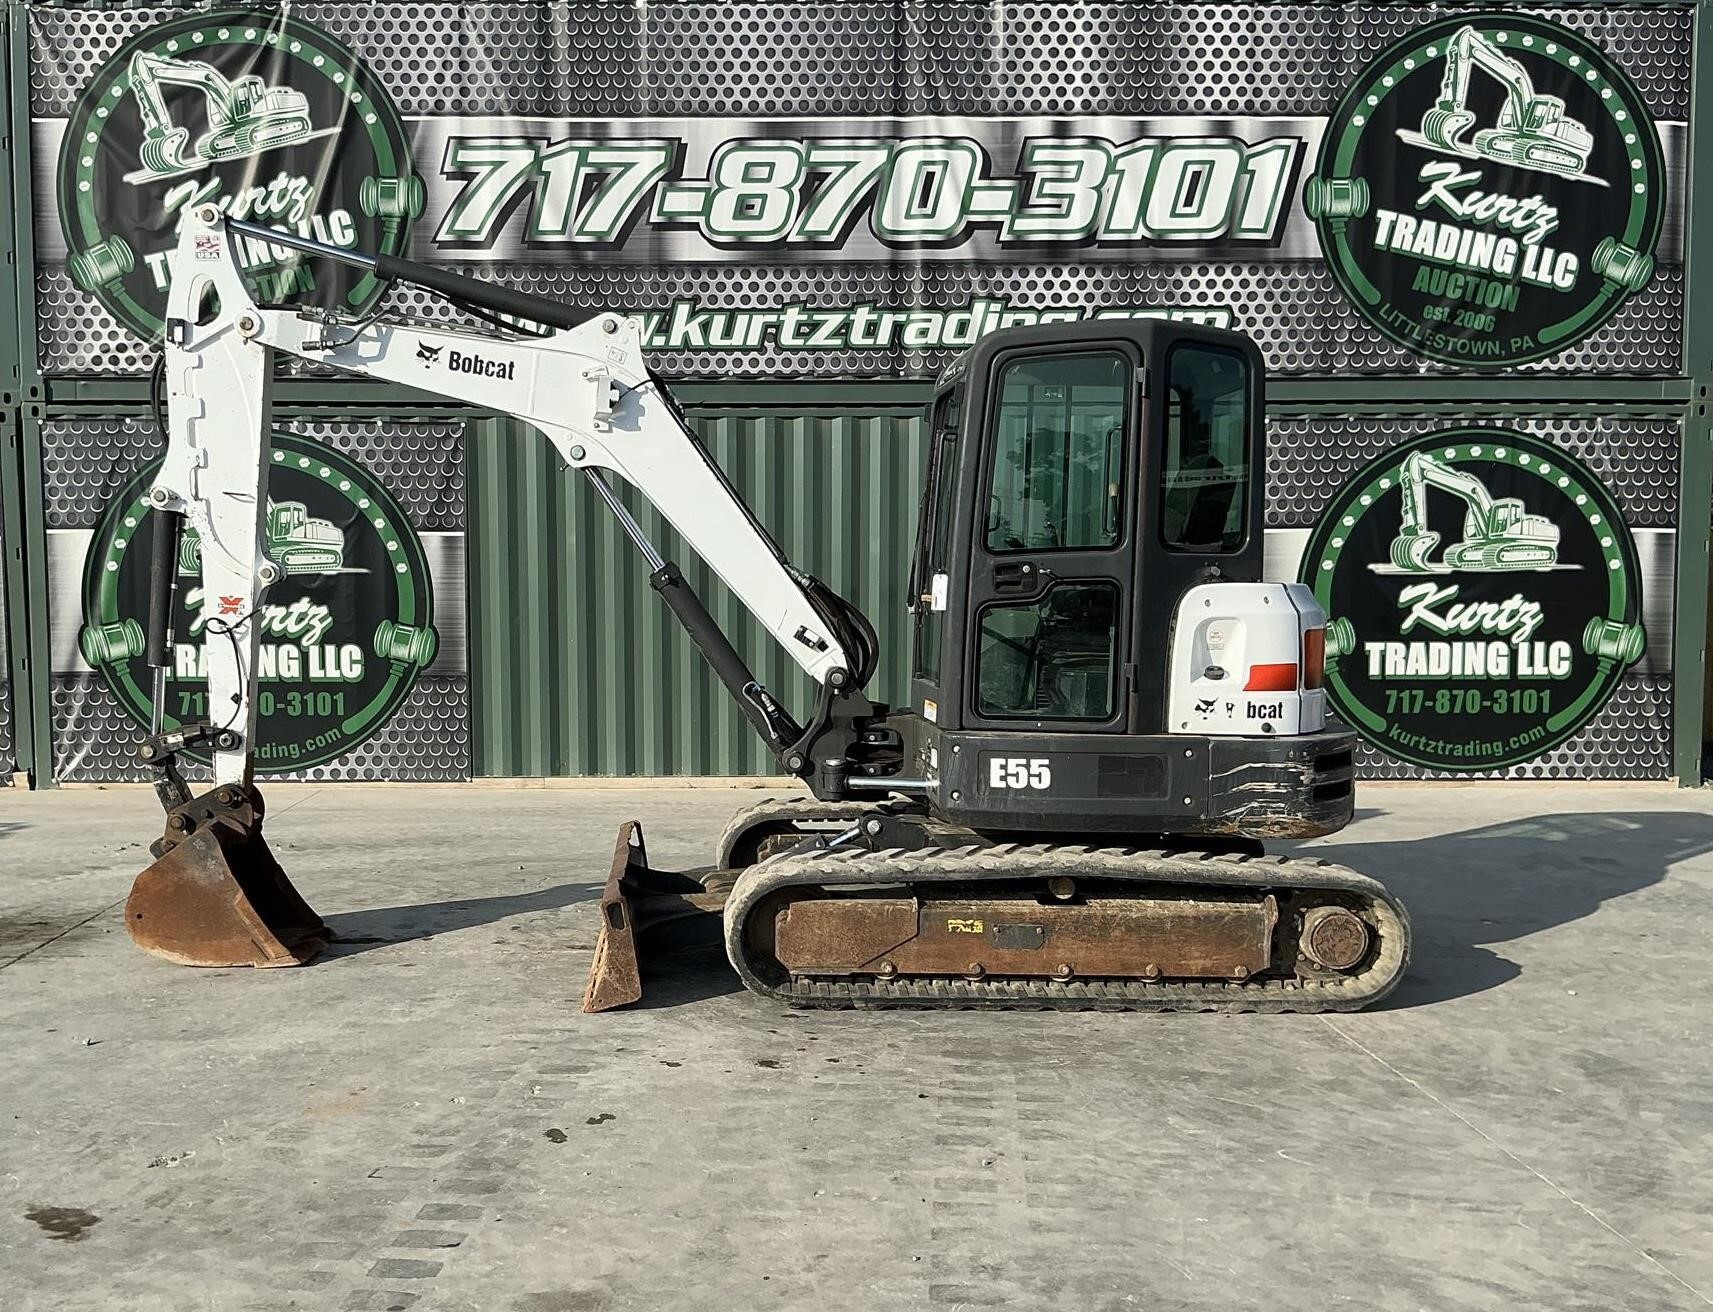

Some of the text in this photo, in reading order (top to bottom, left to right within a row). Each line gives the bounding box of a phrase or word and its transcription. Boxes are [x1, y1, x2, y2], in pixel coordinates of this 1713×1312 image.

[438, 138, 1302, 247] 717-870-3101
[1415, 161, 1559, 247] Kurtz
[1374, 209, 1579, 291] TRADING LLC
[1412, 265, 1520, 312] AUCTION
[1379, 303, 1535, 356] LITTLESTOWN, PA
[1423, 304, 1496, 333] est. 2006
[449, 351, 515, 380] Bobcat
[1398, 582, 1544, 647] Kurtz
[309, 644, 365, 682] LLC
[1365, 641, 1572, 679] TRADING LLC
[179, 691, 344, 717] 710-3101
[1385, 689, 1550, 714] 717-870-3101
[1389, 723, 1545, 757] kurtztrading.com
[990, 758, 1051, 789] E55
